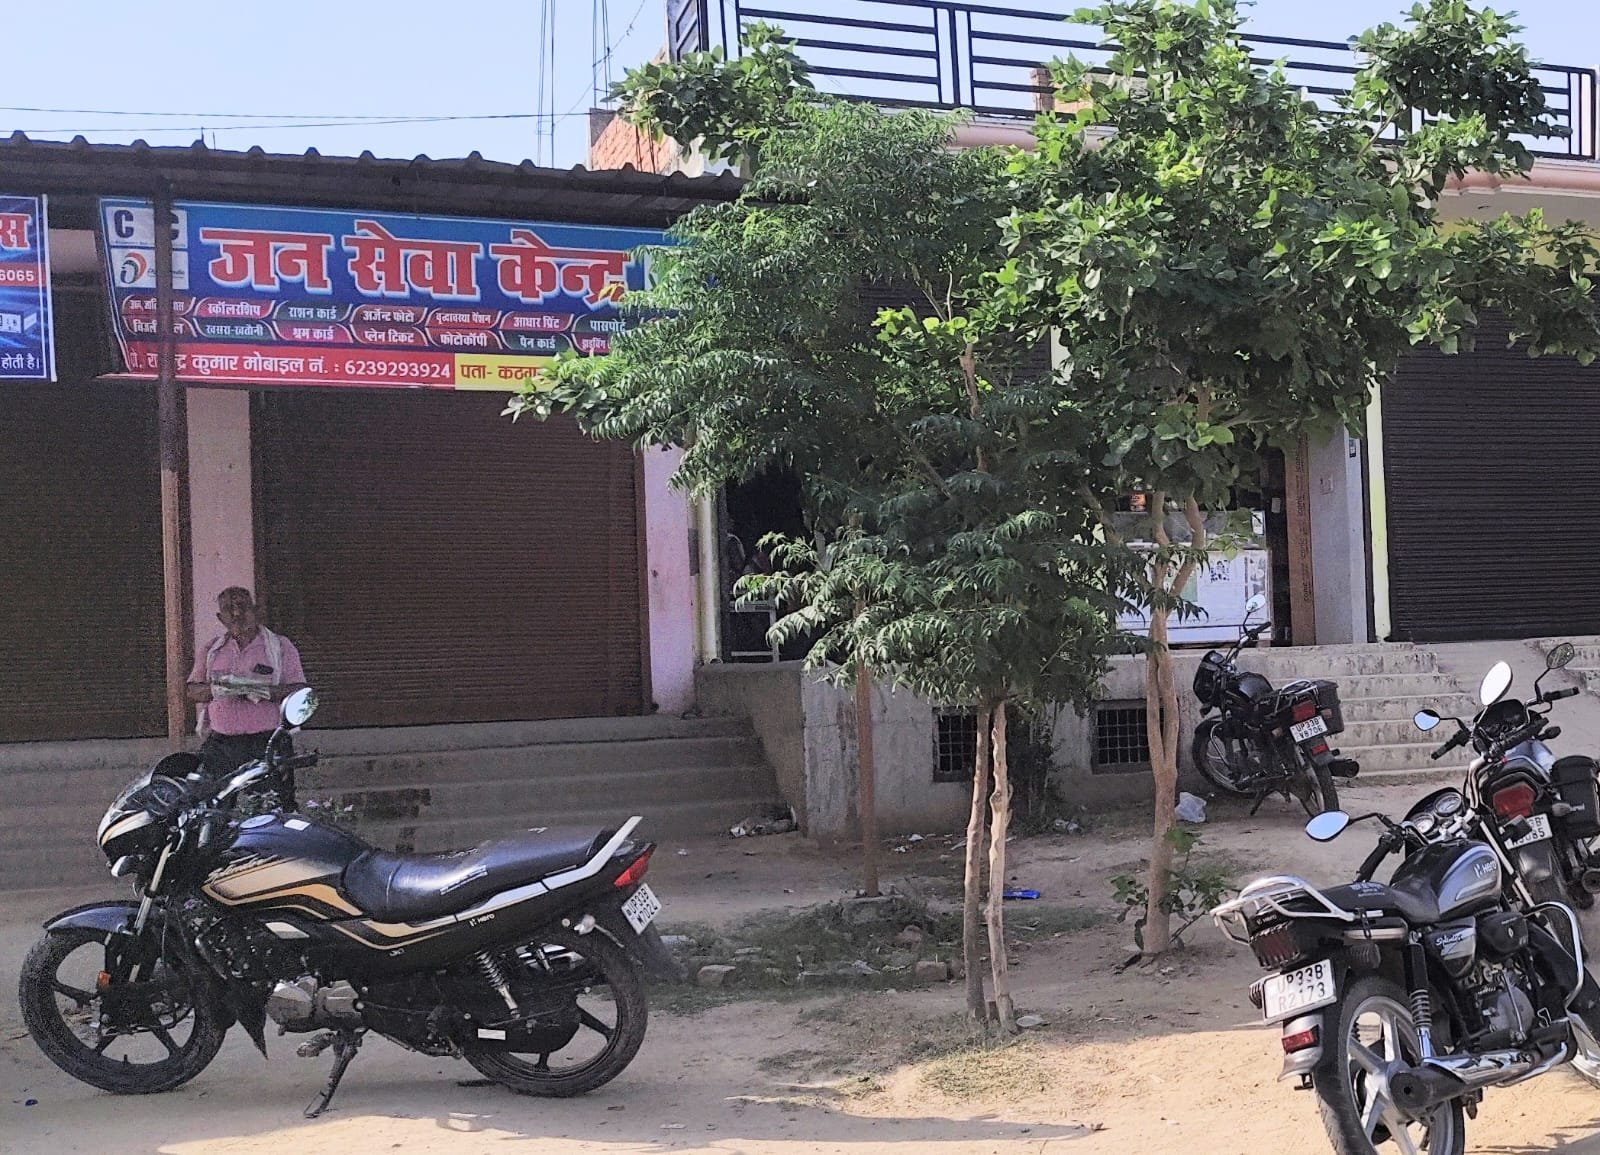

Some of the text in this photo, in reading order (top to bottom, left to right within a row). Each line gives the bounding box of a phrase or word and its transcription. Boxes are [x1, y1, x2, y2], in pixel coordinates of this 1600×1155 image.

[200, 220, 630, 304] जन सेवा केन्द्र
[0, 269, 35, 282] 6065
[207, 301, 262, 316] स्कॉलरशिप
[288, 305, 337, 319] राशन कार्ड
[392, 309, 415, 323] फोटो
[513, 315, 560, 329] आधार प्रिंट
[590, 318, 627, 332] पासपोर्ट
[312, 325, 334, 340] कार्ड
[388, 328, 415, 343] टिकट
[440, 331, 488, 347] फोटोकॉपी
[536, 335, 556, 349] कार्ड
[1, 353, 24, 369] होती
[191, 354, 240, 375] कुमार
[243, 351, 304, 375] मोबाइल
[344, 359, 451, 379] 6239293924
[1276, 963, 1324, 994] UP33B
